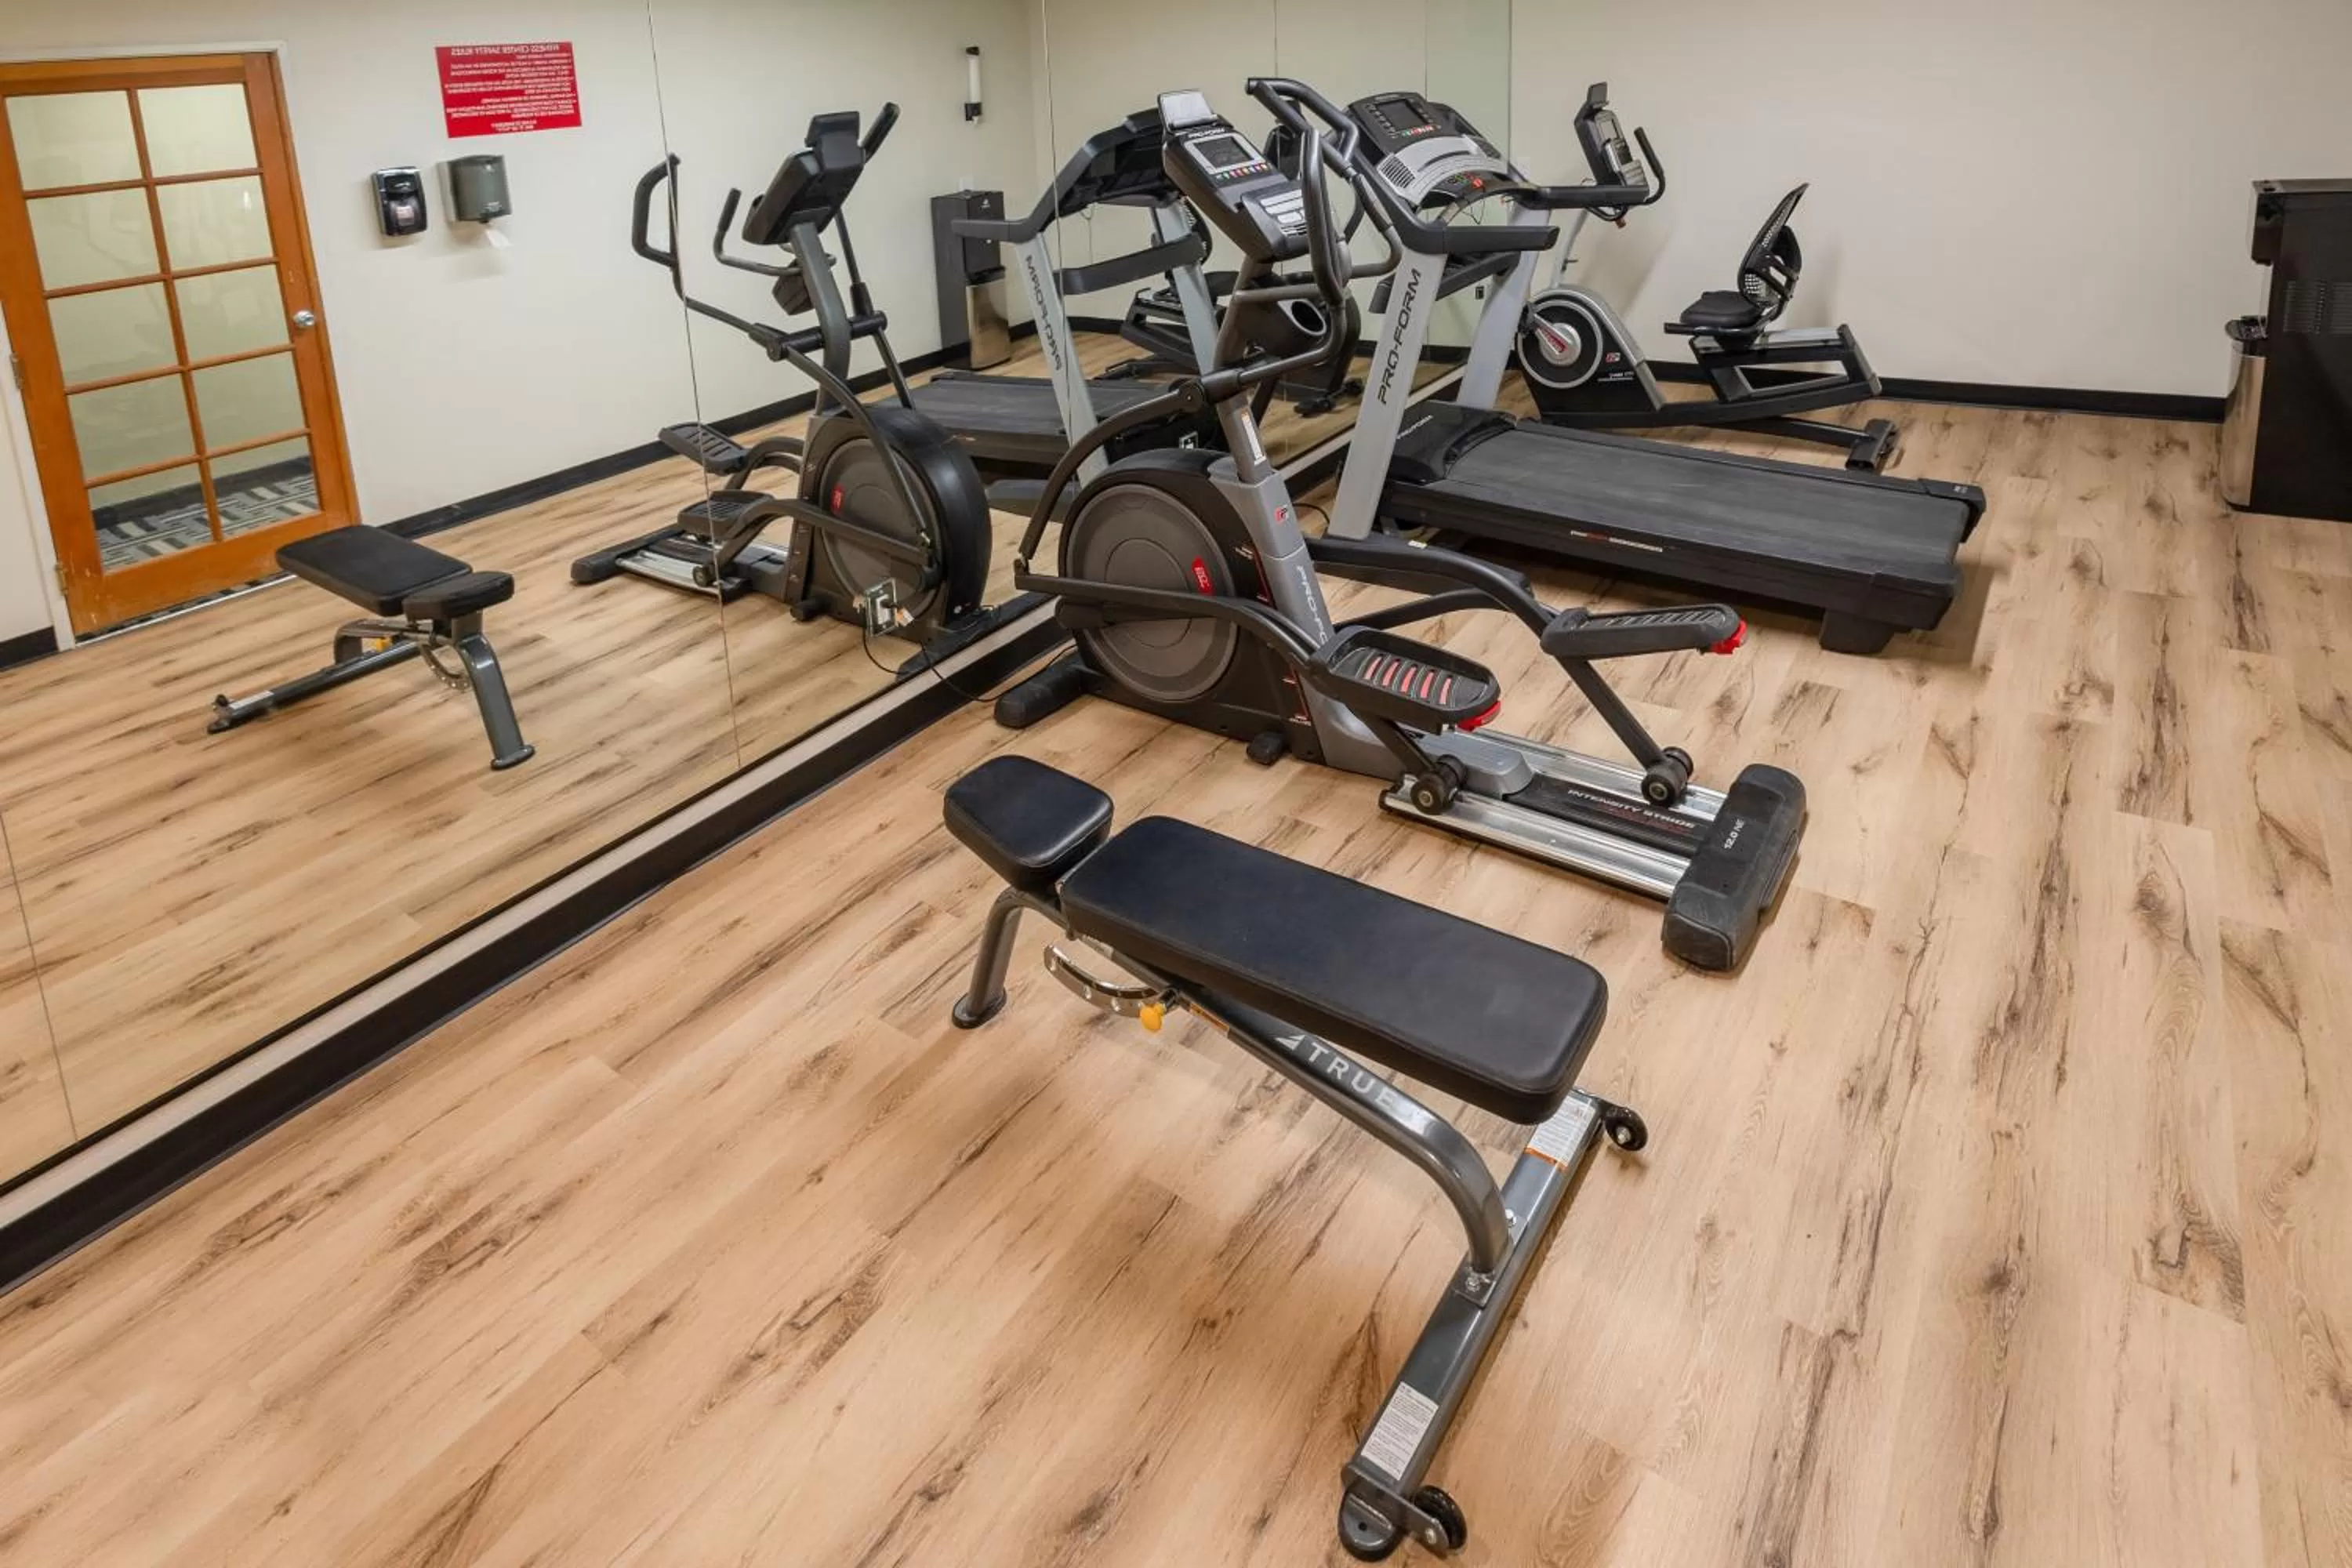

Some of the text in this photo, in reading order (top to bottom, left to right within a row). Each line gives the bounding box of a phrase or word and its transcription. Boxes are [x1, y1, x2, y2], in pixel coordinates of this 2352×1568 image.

[1377, 267, 1421, 405] PRO-FORM
[1296, 565, 1328, 645] PRO-FO
[1308, 1041, 1399, 1109] TRUE
